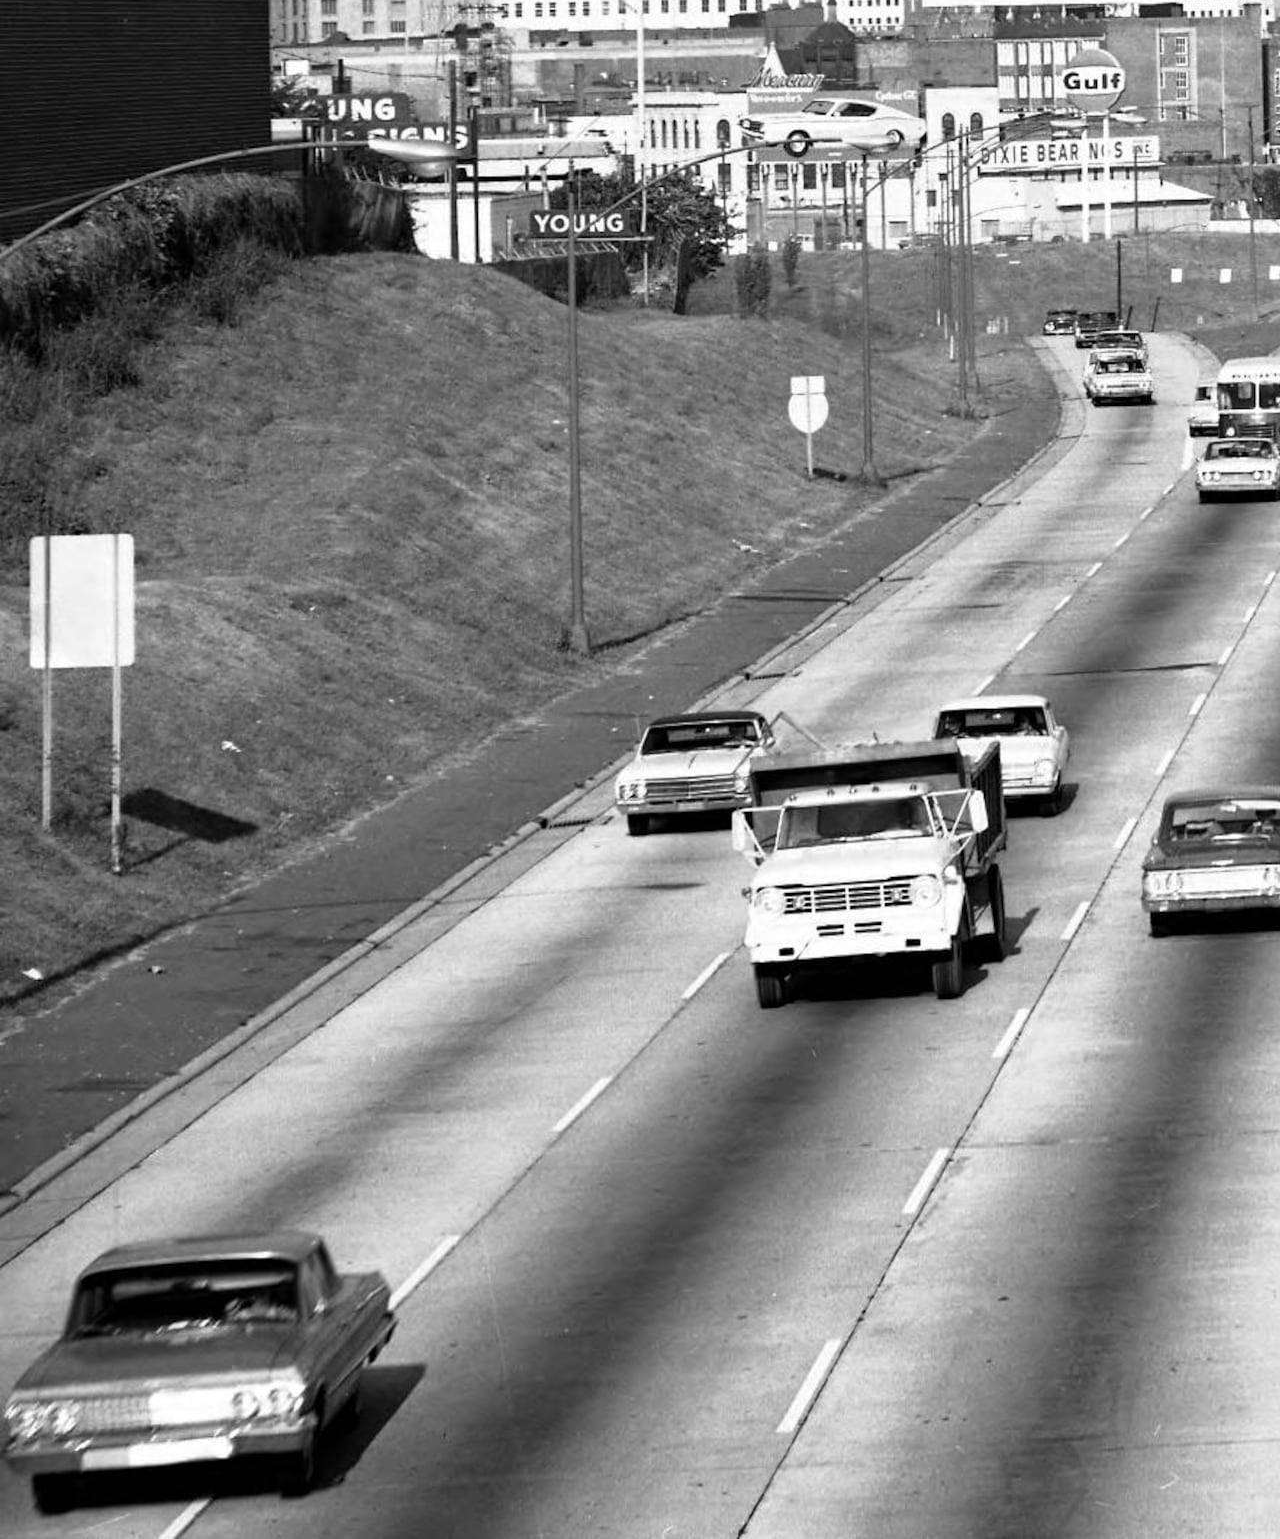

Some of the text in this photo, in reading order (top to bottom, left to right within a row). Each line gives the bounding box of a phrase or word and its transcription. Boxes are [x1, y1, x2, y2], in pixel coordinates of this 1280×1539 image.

[740, 64, 825, 93] Mercury
[1064, 72, 1121, 90] Gulf
[981, 146, 1028, 165] DIXIE
[1037, 142, 1123, 162] BEARNS
[534, 212, 624, 233] YOUNG
